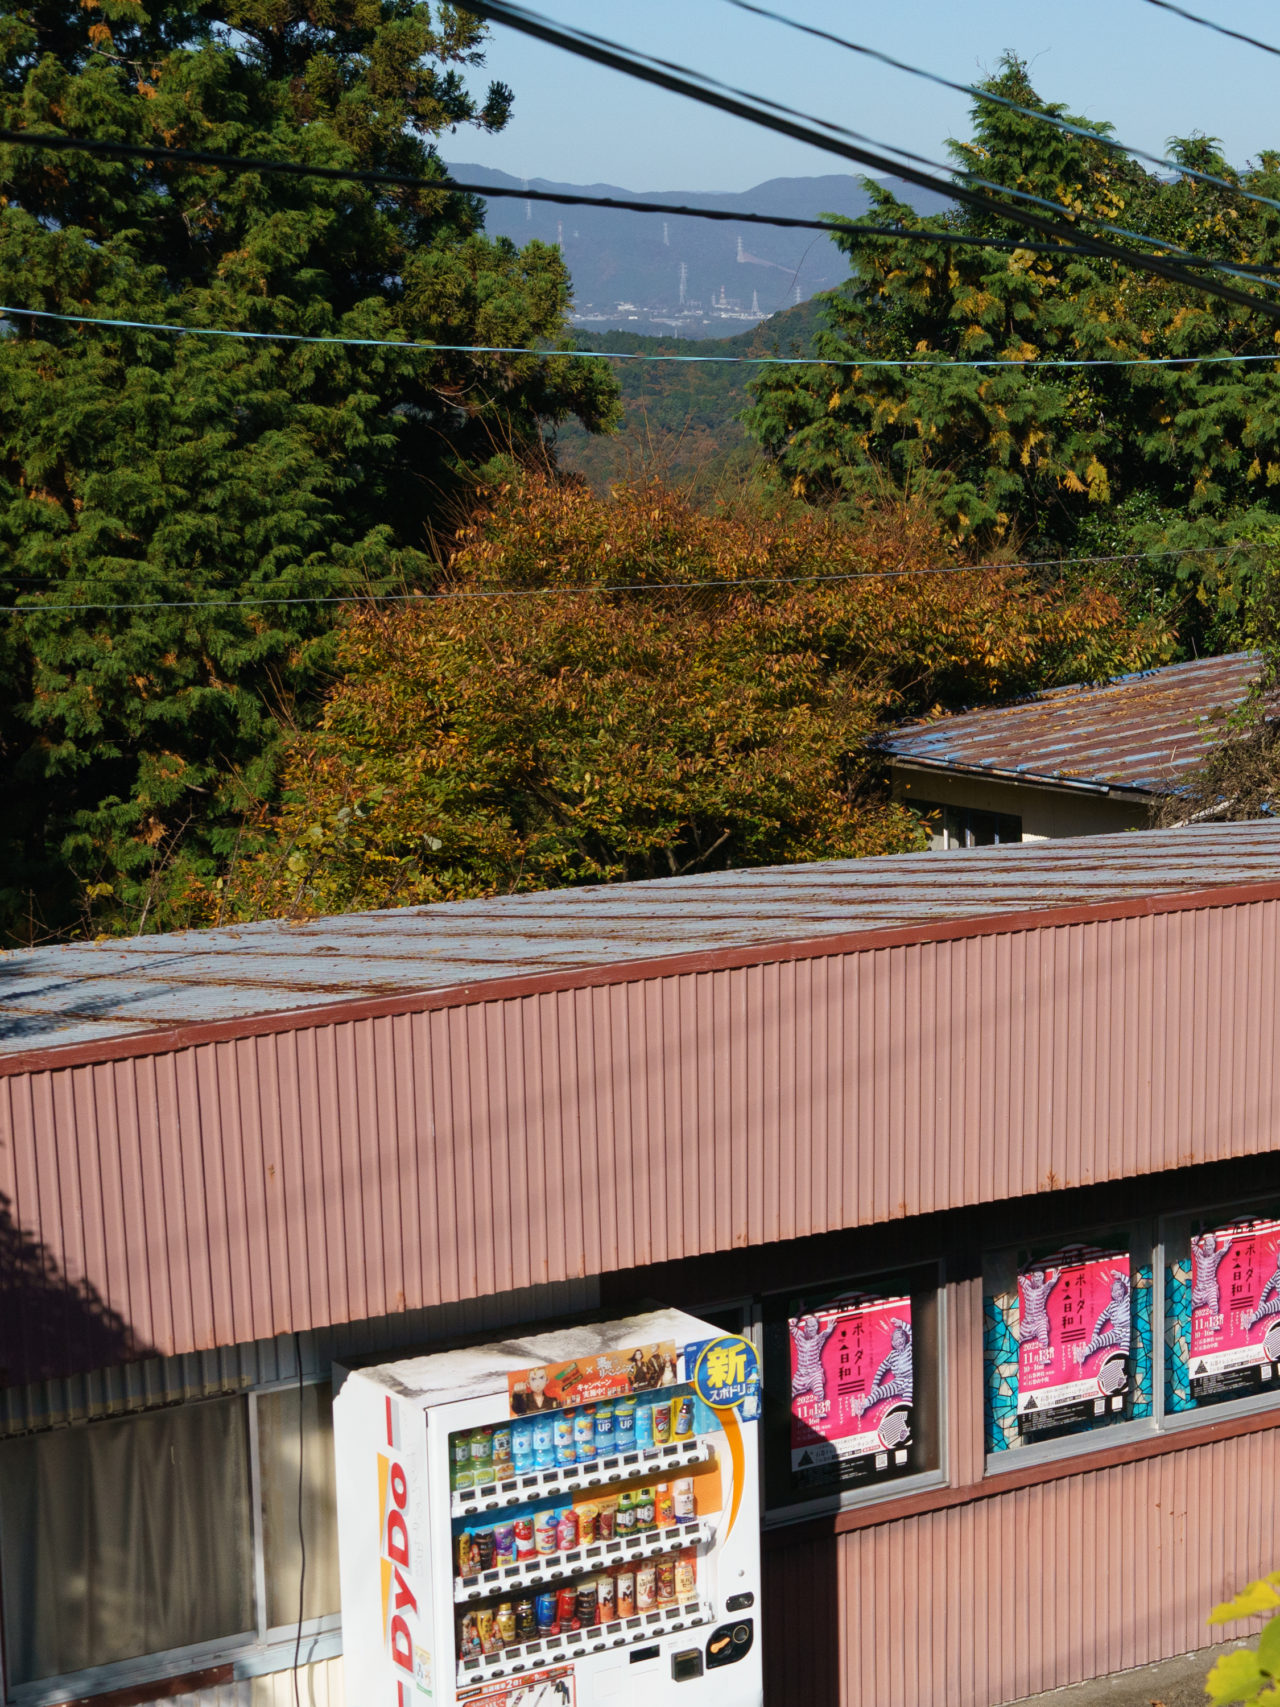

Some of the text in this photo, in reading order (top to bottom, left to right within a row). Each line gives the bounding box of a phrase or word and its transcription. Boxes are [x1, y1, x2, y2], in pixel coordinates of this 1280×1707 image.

[1245, 1242, 1257, 1293] ボーダー
[1075, 1273, 1087, 1325] ボーダー
[707, 1342, 747, 1389] 新
[851, 1321, 865, 1376] ボーダー
[577, 1379, 613, 1392] キャンペーン
[709, 1383, 746, 1403] スポドリ
[598, 1423, 611, 1432] UP
[620, 1420, 633, 1429] UP
[387, 1461, 419, 1674] DyDo
